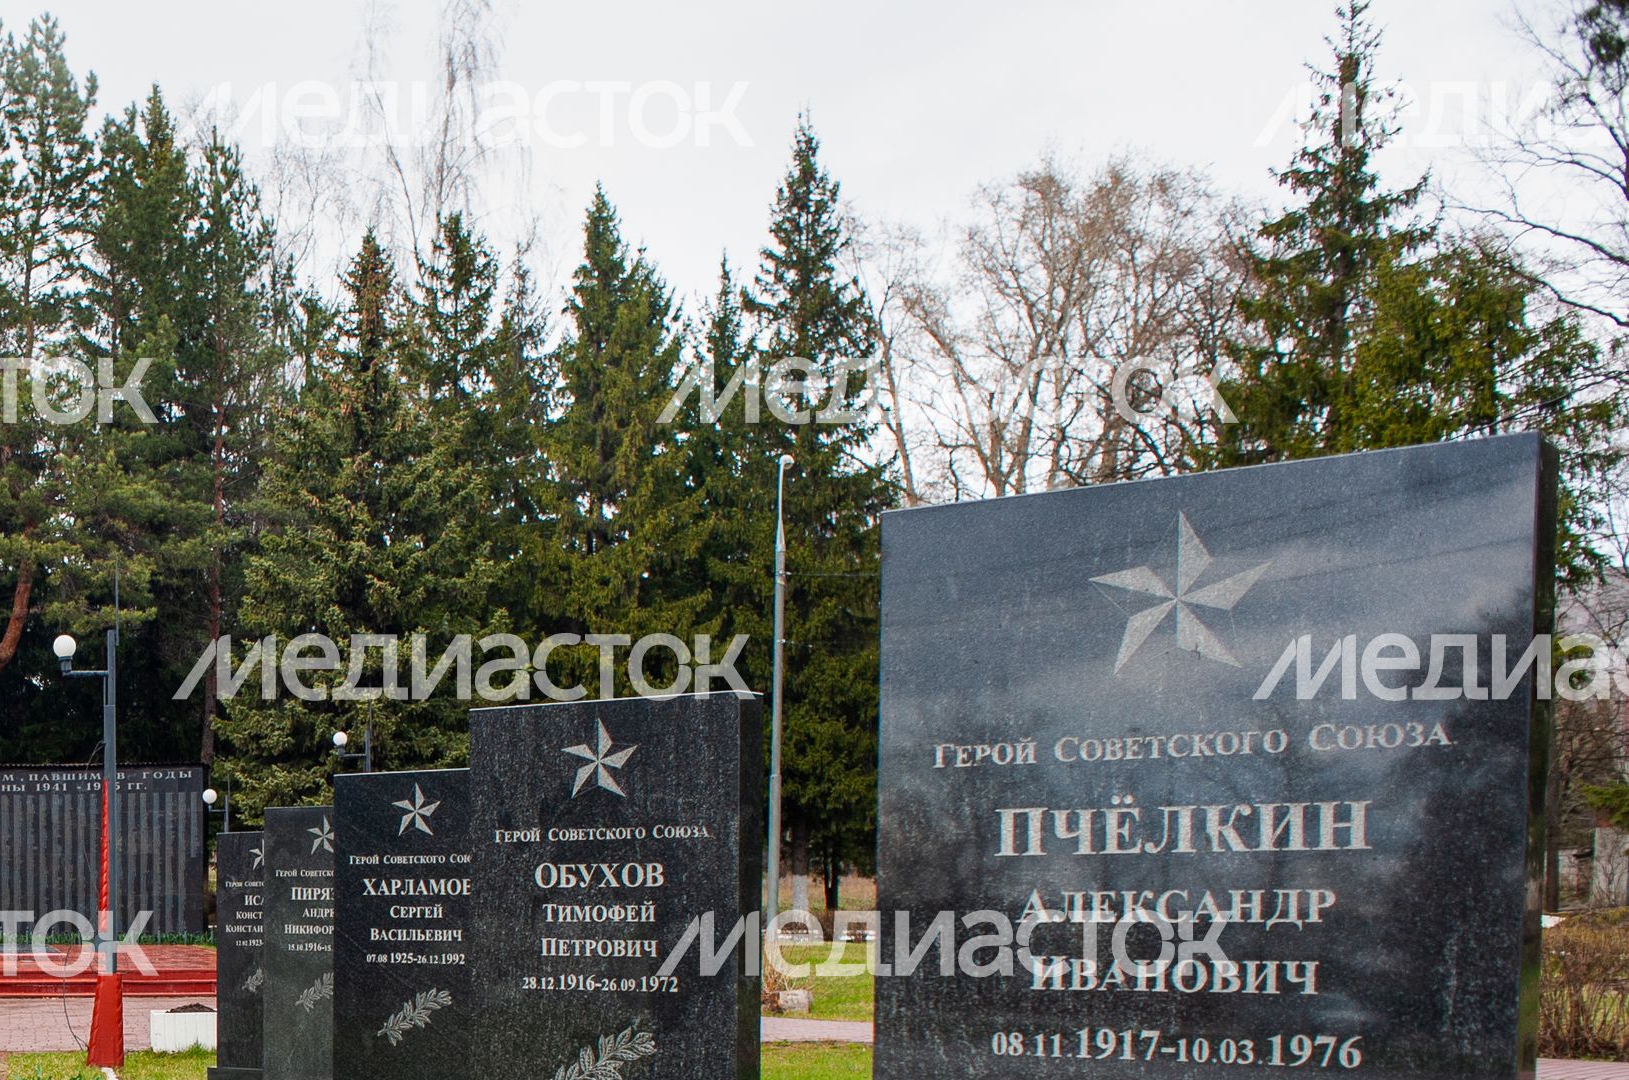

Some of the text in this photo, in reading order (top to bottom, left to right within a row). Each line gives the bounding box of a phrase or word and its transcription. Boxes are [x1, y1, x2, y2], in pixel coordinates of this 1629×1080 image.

[29, 773, 101, 782] ПАВШИМ
[142, 770, 193, 780] ГОДЫ
[994, 795, 1373, 857] ПЧЁЛКИН
[534, 862, 665, 889] ОБУХОВ
[390, 904, 443, 918] СЕРГЕЙ
[543, 901, 656, 923] ТИМОФЕЙ
[1015, 888, 1336, 932] АЛЕКСАНДР
[370, 928, 463, 942] ВАСИЛЬЕВИЧ
[540, 937, 658, 957] ПЕТРОВИЧ
[1030, 955, 1320, 995] ИВАНОВИЧ
